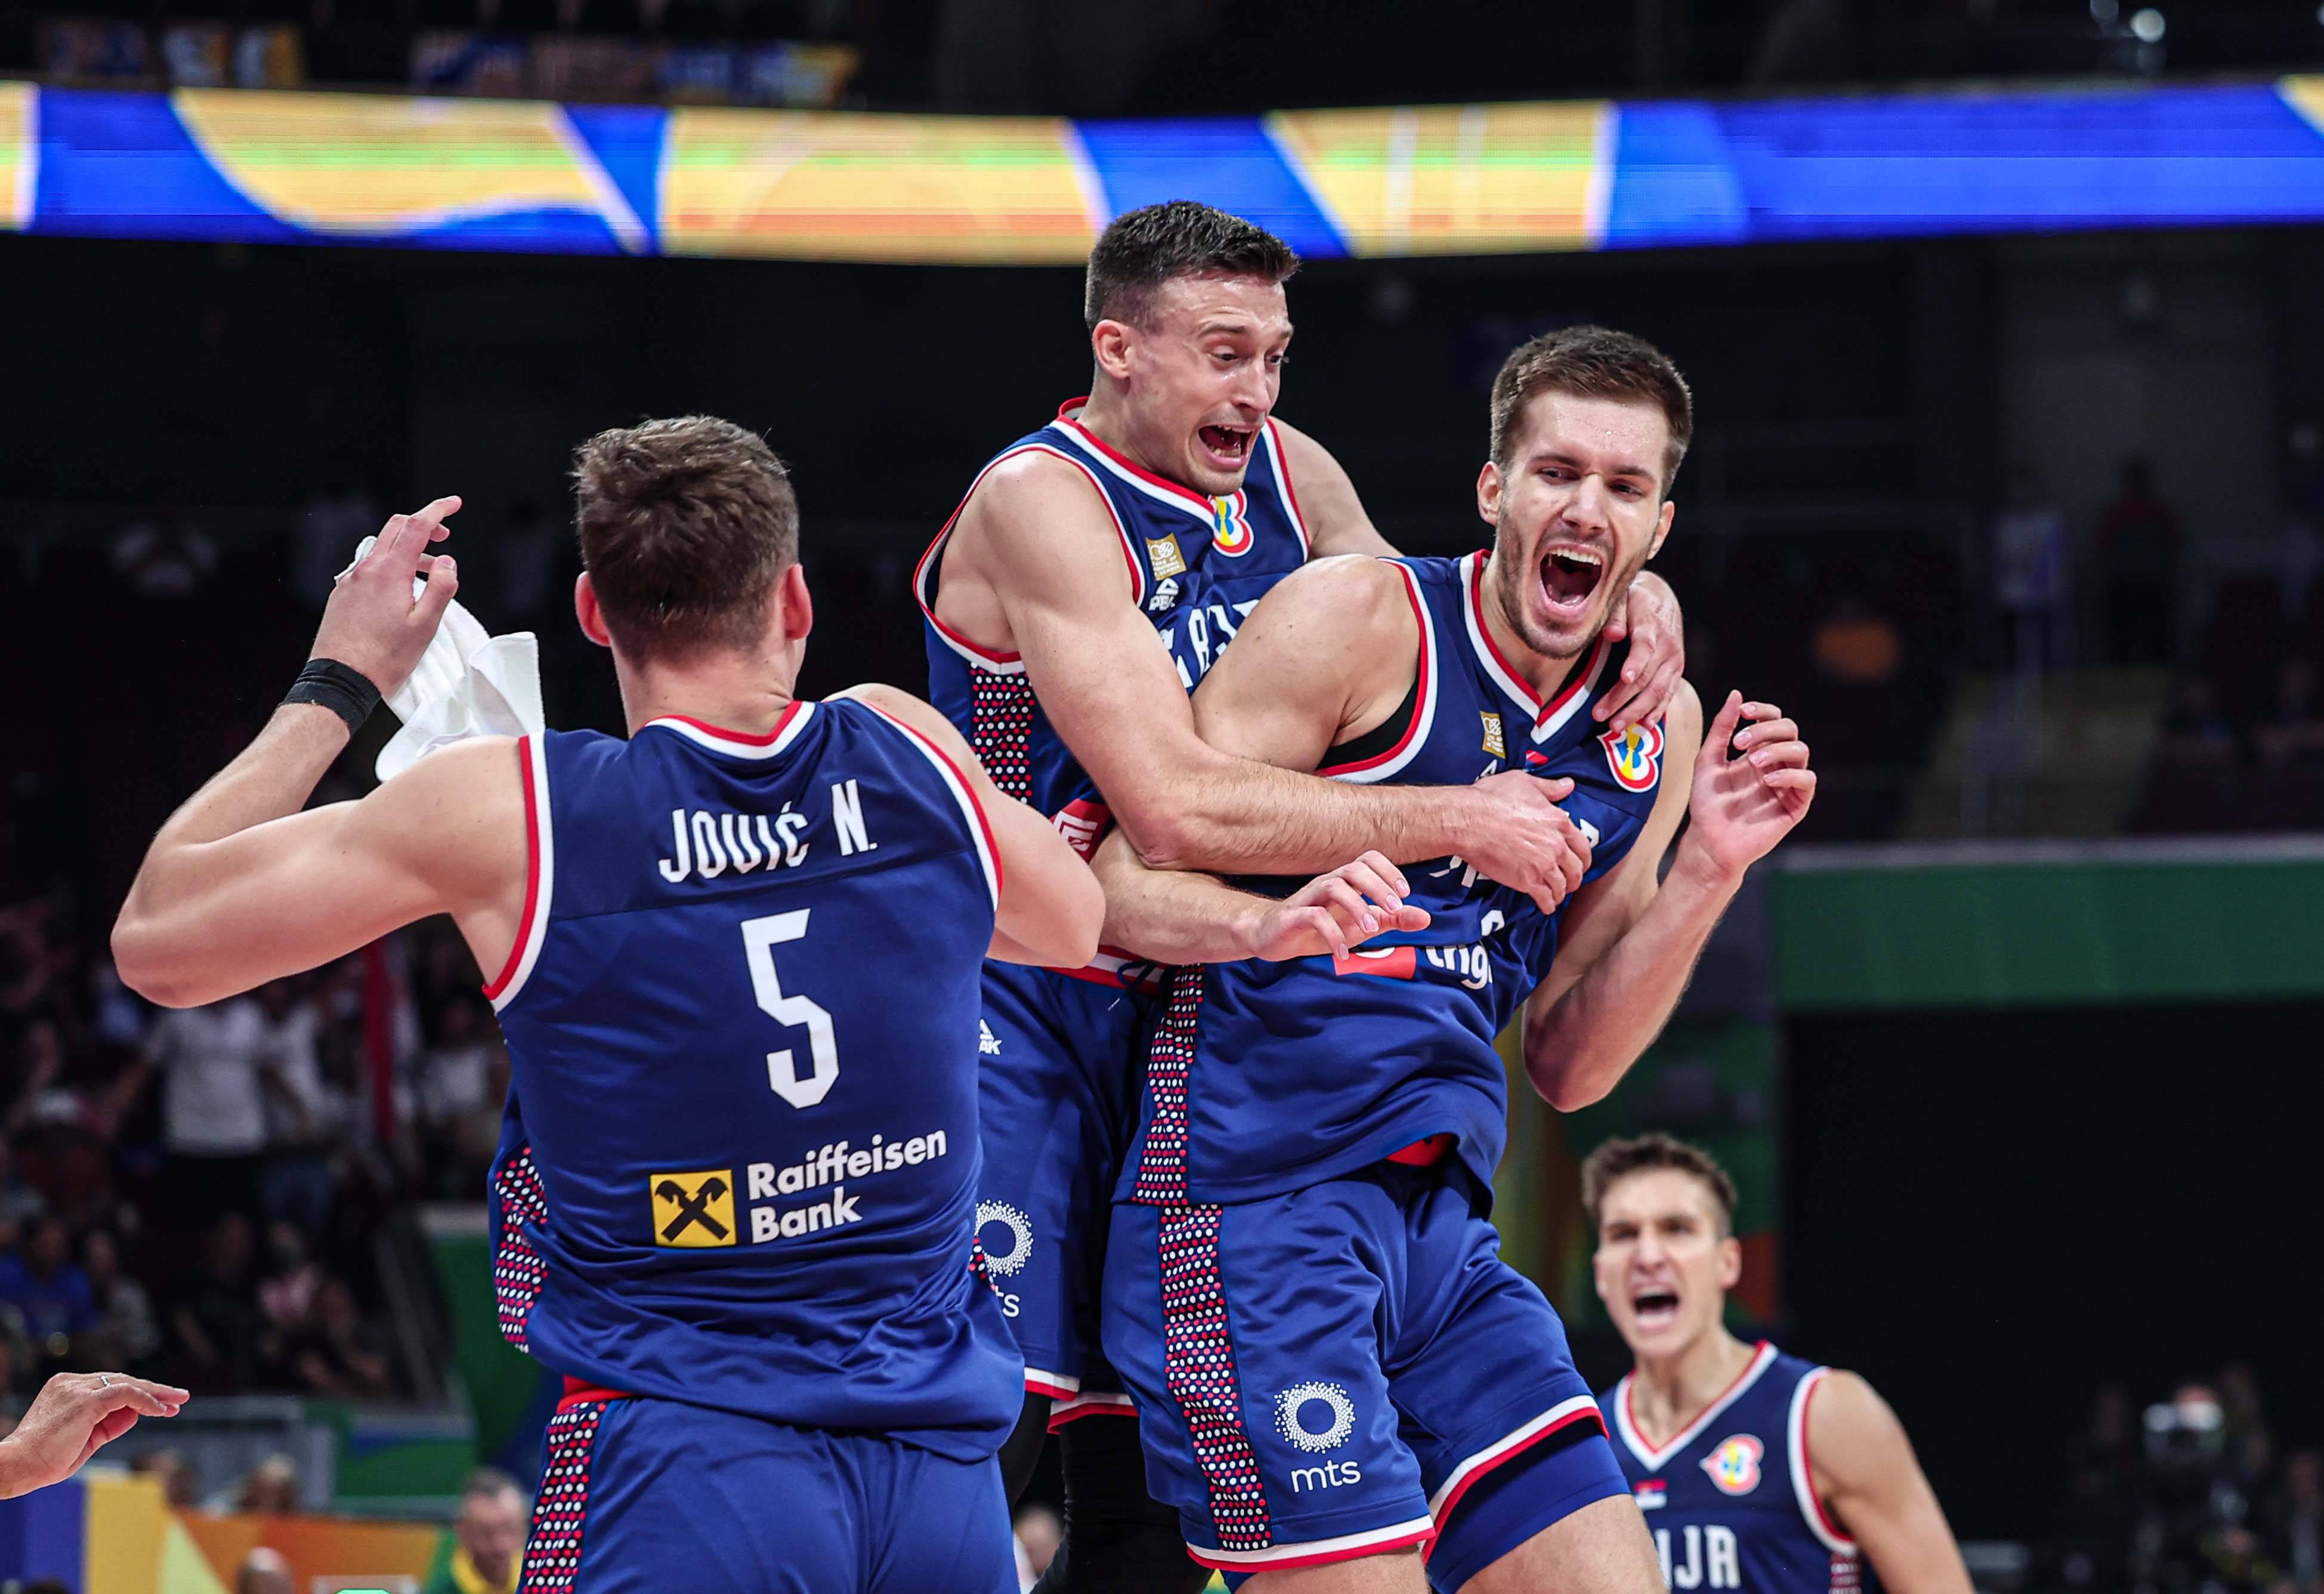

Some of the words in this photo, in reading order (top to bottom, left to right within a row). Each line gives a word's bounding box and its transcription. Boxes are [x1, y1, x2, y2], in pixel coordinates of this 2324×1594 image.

[831, 779, 877, 856] N.
[740, 908, 840, 1109] 5
[747, 1130, 947, 1200] Raiffeisen
[750, 1185, 863, 1244] Bank
[1291, 1460, 1361, 1493] mts
